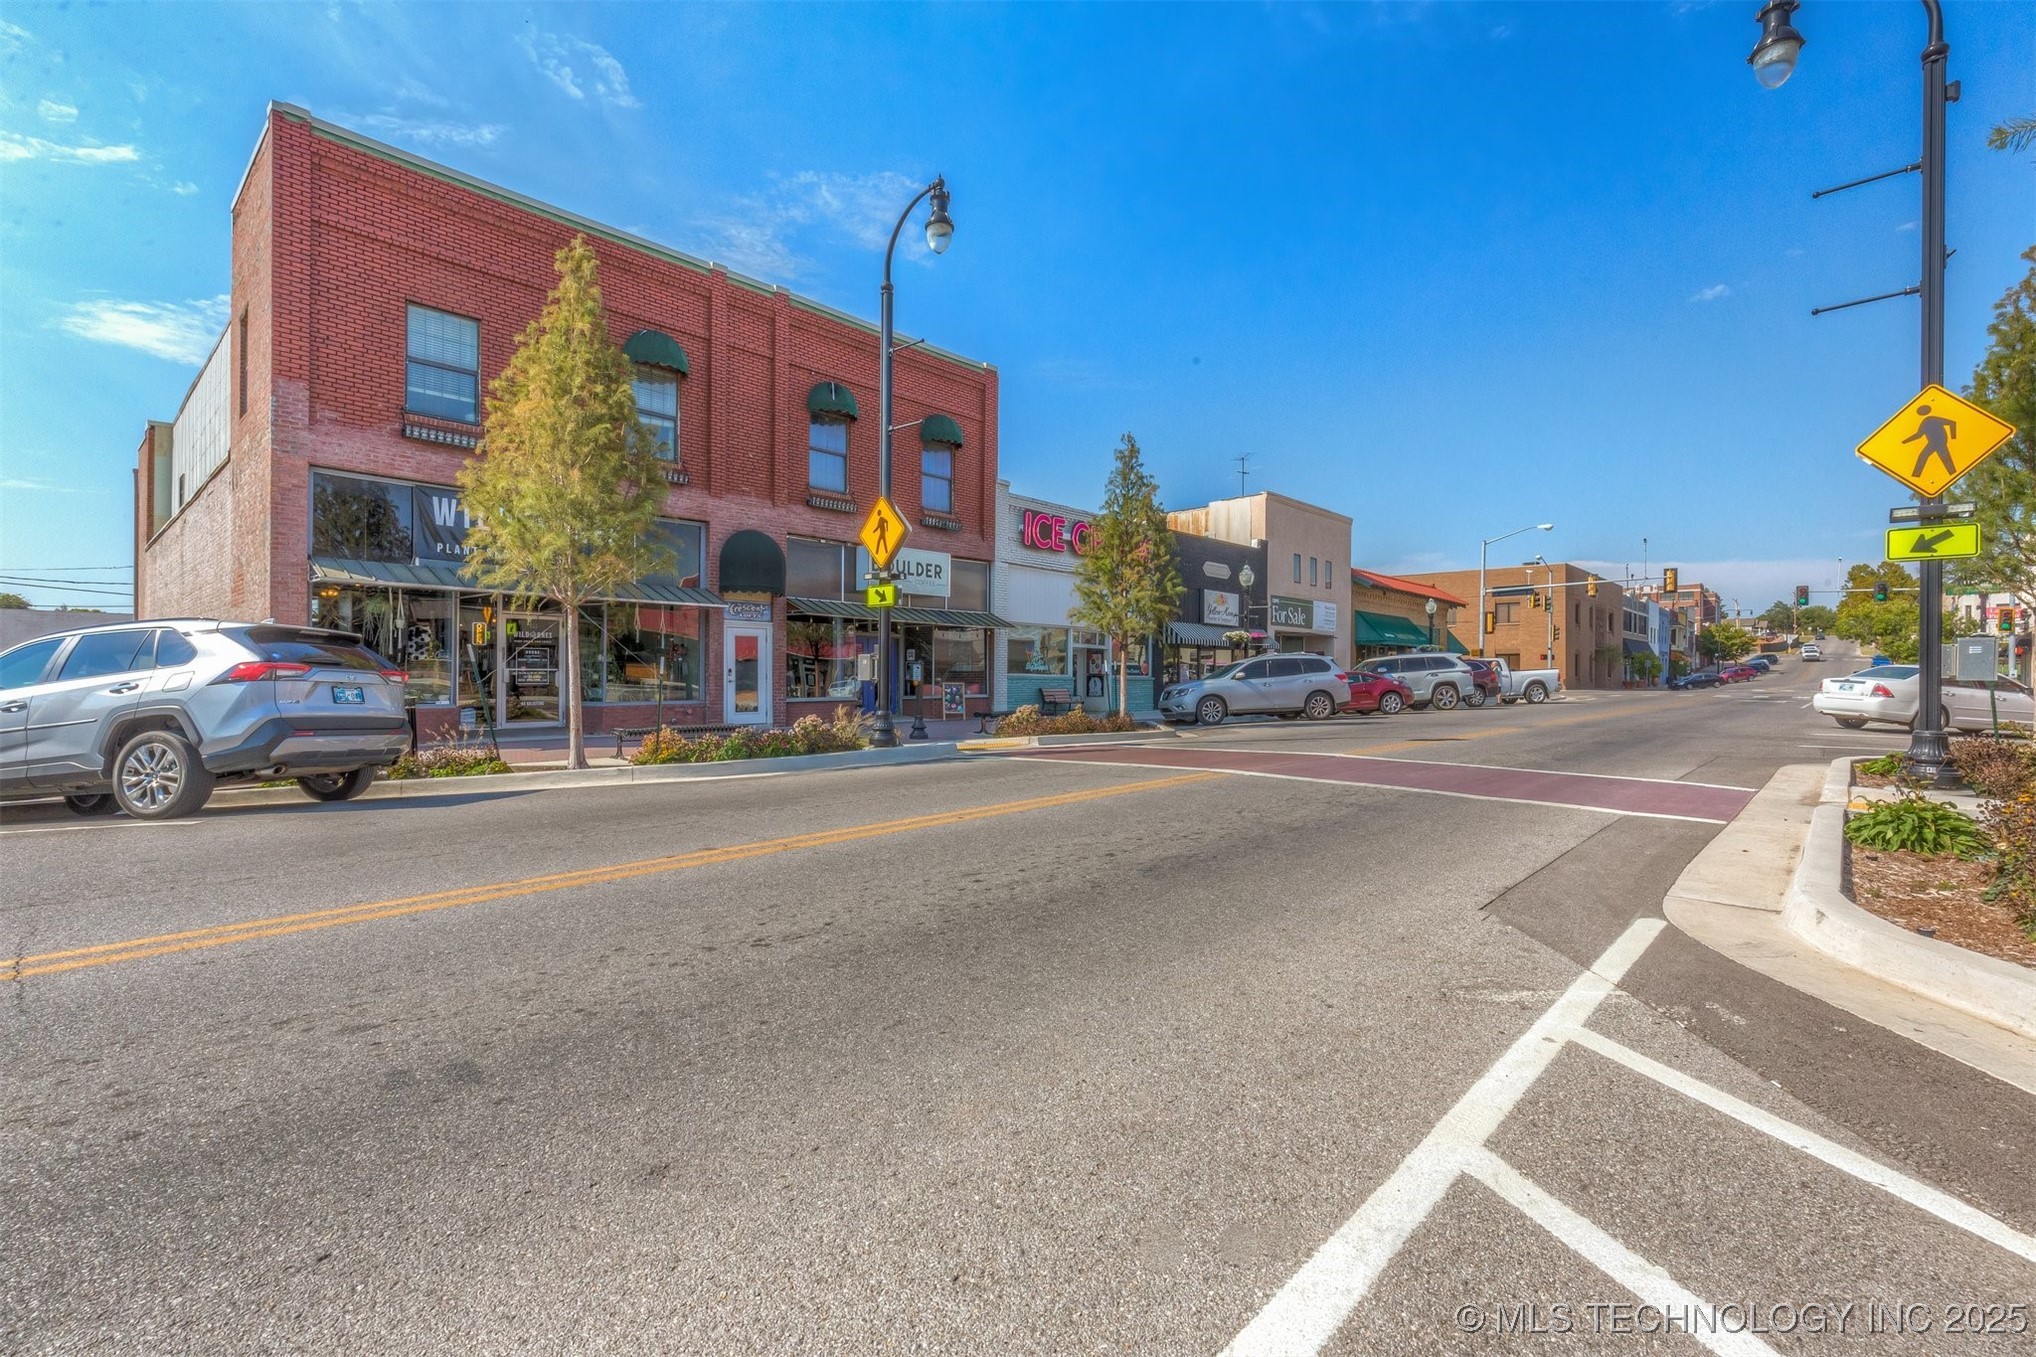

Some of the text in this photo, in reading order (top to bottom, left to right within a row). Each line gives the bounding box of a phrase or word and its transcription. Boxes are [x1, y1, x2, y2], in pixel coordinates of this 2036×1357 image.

[1024, 511, 1067, 552] ICE
[872, 557, 943, 580] ULDER
[1272, 605, 1287, 624] For
[1288, 606, 1306, 625] Sale
